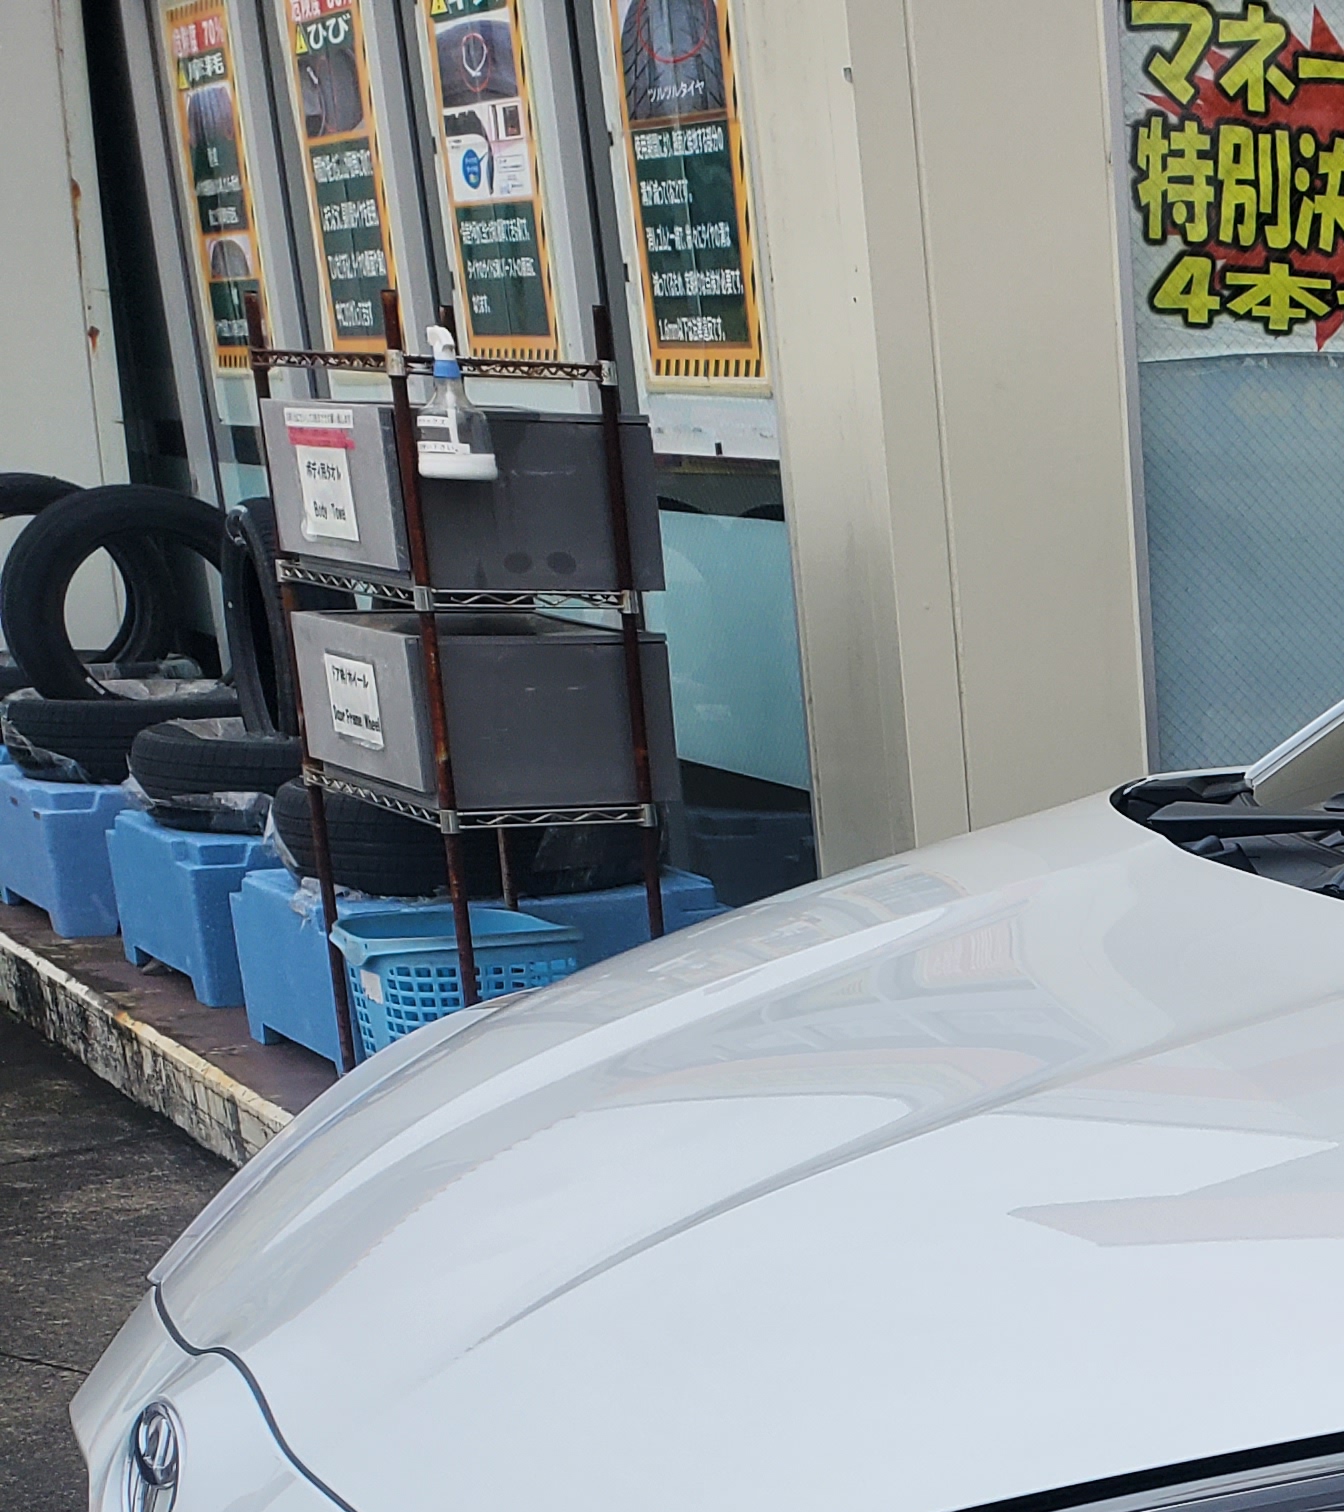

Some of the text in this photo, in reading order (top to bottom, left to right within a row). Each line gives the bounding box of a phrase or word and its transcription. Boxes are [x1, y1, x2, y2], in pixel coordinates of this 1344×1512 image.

[307, 13, 352, 50] ひび
[647, 80, 705, 102] ツルツルタイヤ
[312, 500, 328, 521] Body
